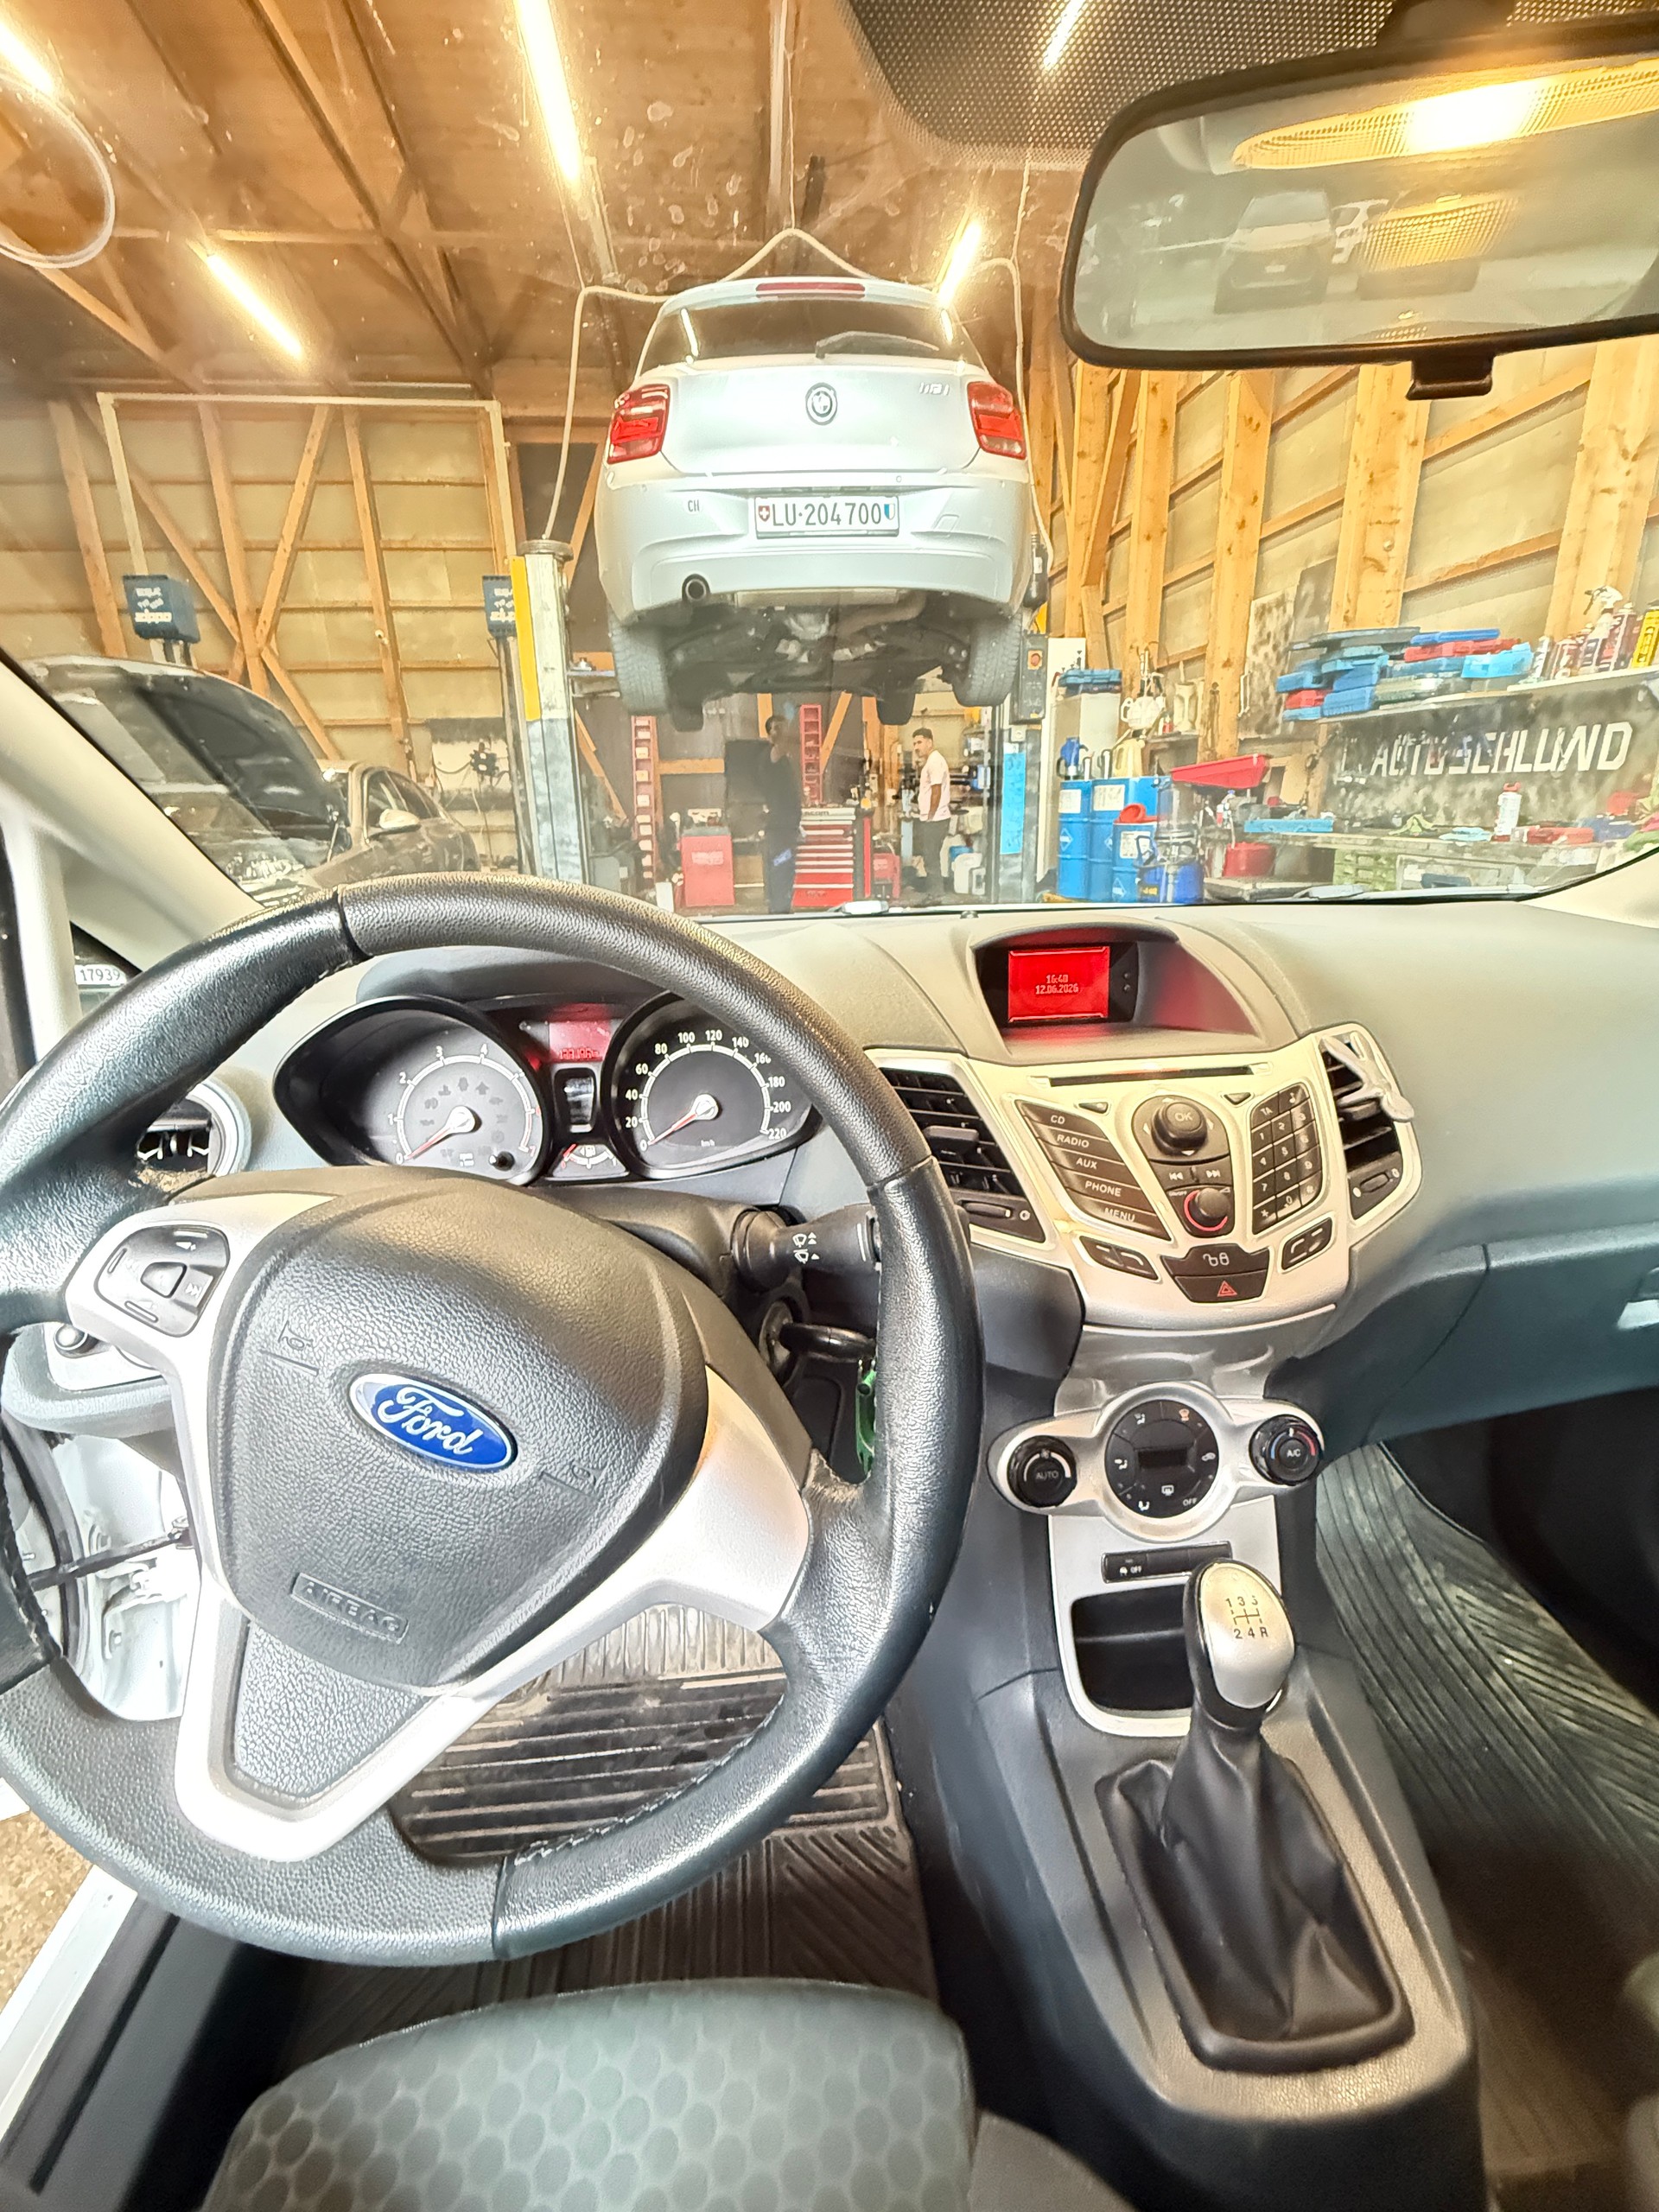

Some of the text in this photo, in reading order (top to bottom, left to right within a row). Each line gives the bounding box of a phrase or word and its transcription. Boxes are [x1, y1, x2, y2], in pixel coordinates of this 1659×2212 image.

[688, 499, 700, 512] CH
[677, 1032, 696, 1043] 100
[705, 1029, 722, 1041] 120
[654, 1043, 668, 1054] 80
[732, 1037, 749, 1048] 140
[435, 1046, 444, 1058] 3
[480, 1043, 488, 1056] 4
[754, 1052, 772, 1064] 160
[635, 1063, 648, 1075] 60
[398, 1071, 407, 1084] 2
[767, 1076, 785, 1087] 180
[626, 1089, 639, 1101] 40
[773, 1101, 791, 1112] 200
[1260, 1107, 1274, 1116] TA
[626, 1117, 639, 1128] 20
[1050, 1115, 1065, 1125] CD
[1174, 1111, 1193, 1122] OK
[768, 1128, 787, 1140] 220
[639, 1141, 647, 1151] 0
[1056, 1134, 1090, 1148] RADIO
[395, 1153, 404, 1165] 0
[1076, 1157, 1098, 1170] AUX
[1084, 1180, 1122, 1198] PHONE
[1104, 1207, 1136, 1223] MENU
[377, 1385, 481, 1455] Ford
[1035, 1470, 1059, 1480] AUTO
[1182, 1497, 1198, 1506] OFF
[1237, 1596, 1245, 1606] 3
[1233, 1626, 1268, 1639] 2 4 R
